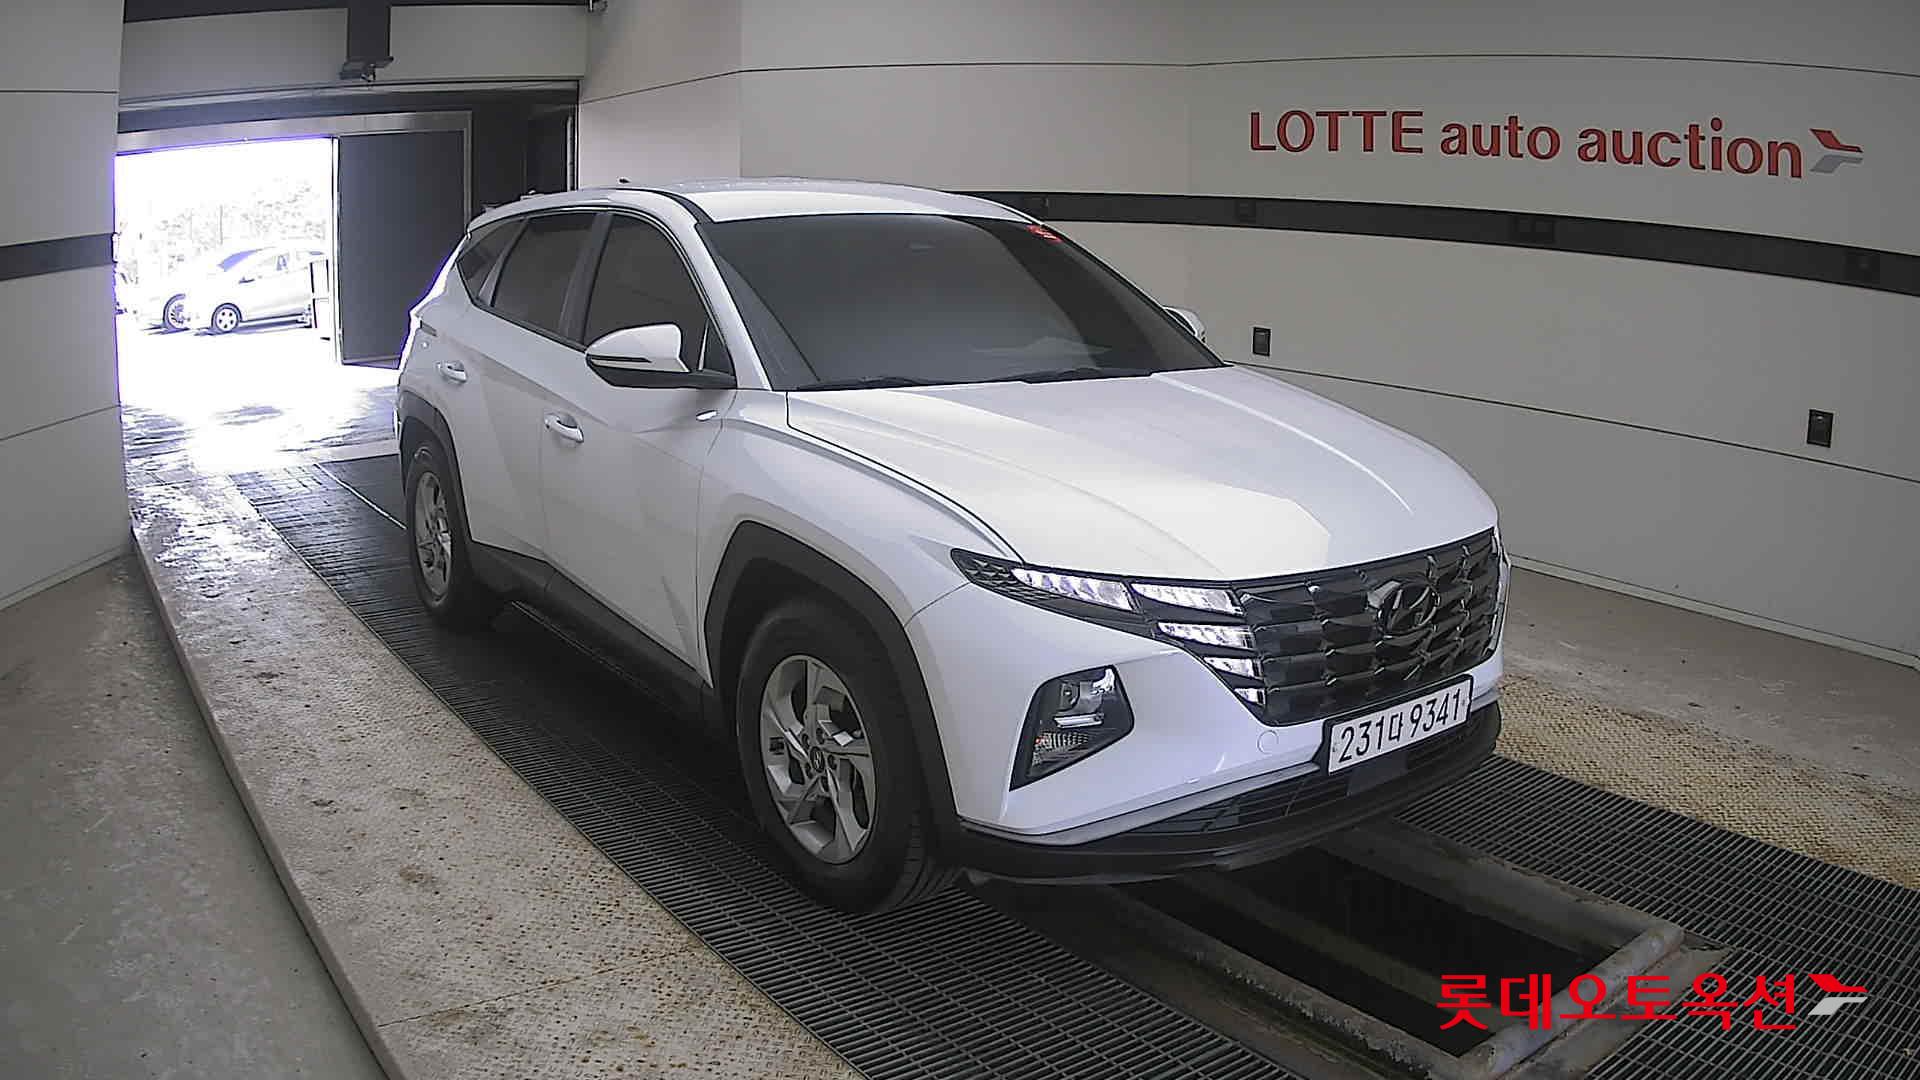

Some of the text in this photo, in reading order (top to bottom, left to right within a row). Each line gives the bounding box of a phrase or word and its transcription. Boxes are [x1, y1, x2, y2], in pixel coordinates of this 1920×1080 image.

[1249, 110, 1802, 179] LOTTE auto auction
[1410, 688, 1462, 738] 9341
